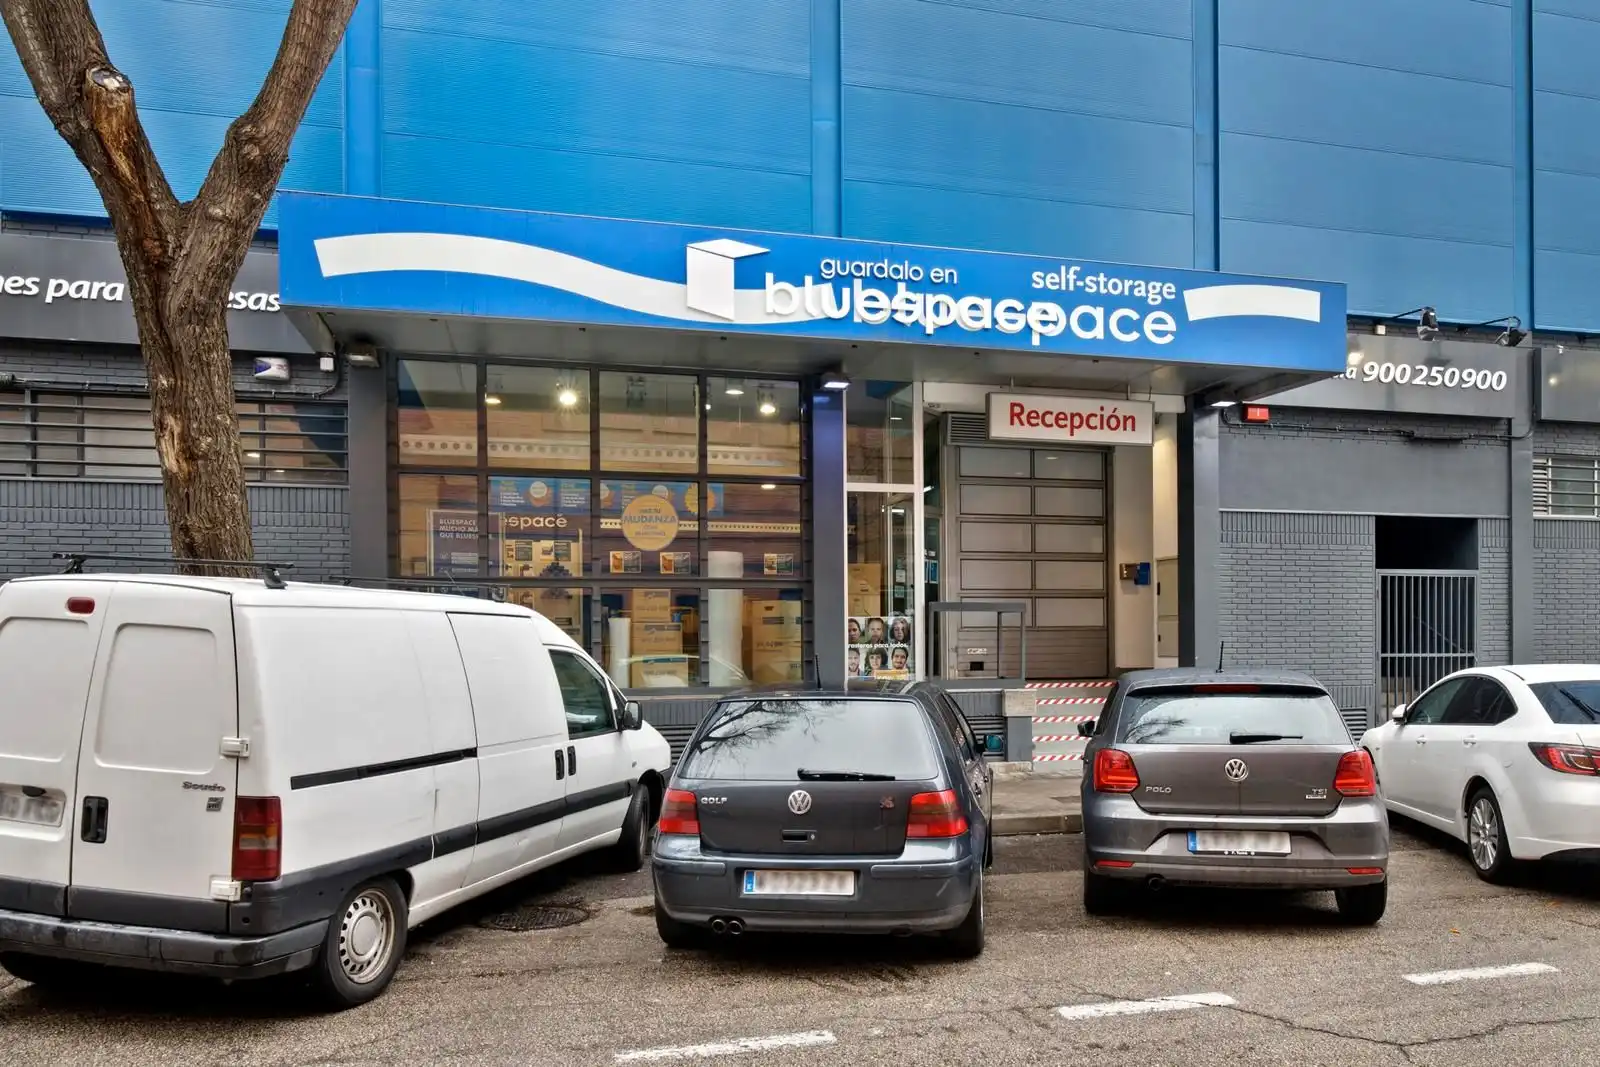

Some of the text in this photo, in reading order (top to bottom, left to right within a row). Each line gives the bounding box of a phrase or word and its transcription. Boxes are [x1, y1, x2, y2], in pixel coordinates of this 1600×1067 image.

[820, 258, 958, 284] guardalo en
[44, 278, 125, 304] para
[1031, 264, 1177, 306] self-storage
[1008, 401, 1137, 437] Recepción
[700, 796, 728, 805] GOLF
[1145, 785, 1173, 794] POLO
